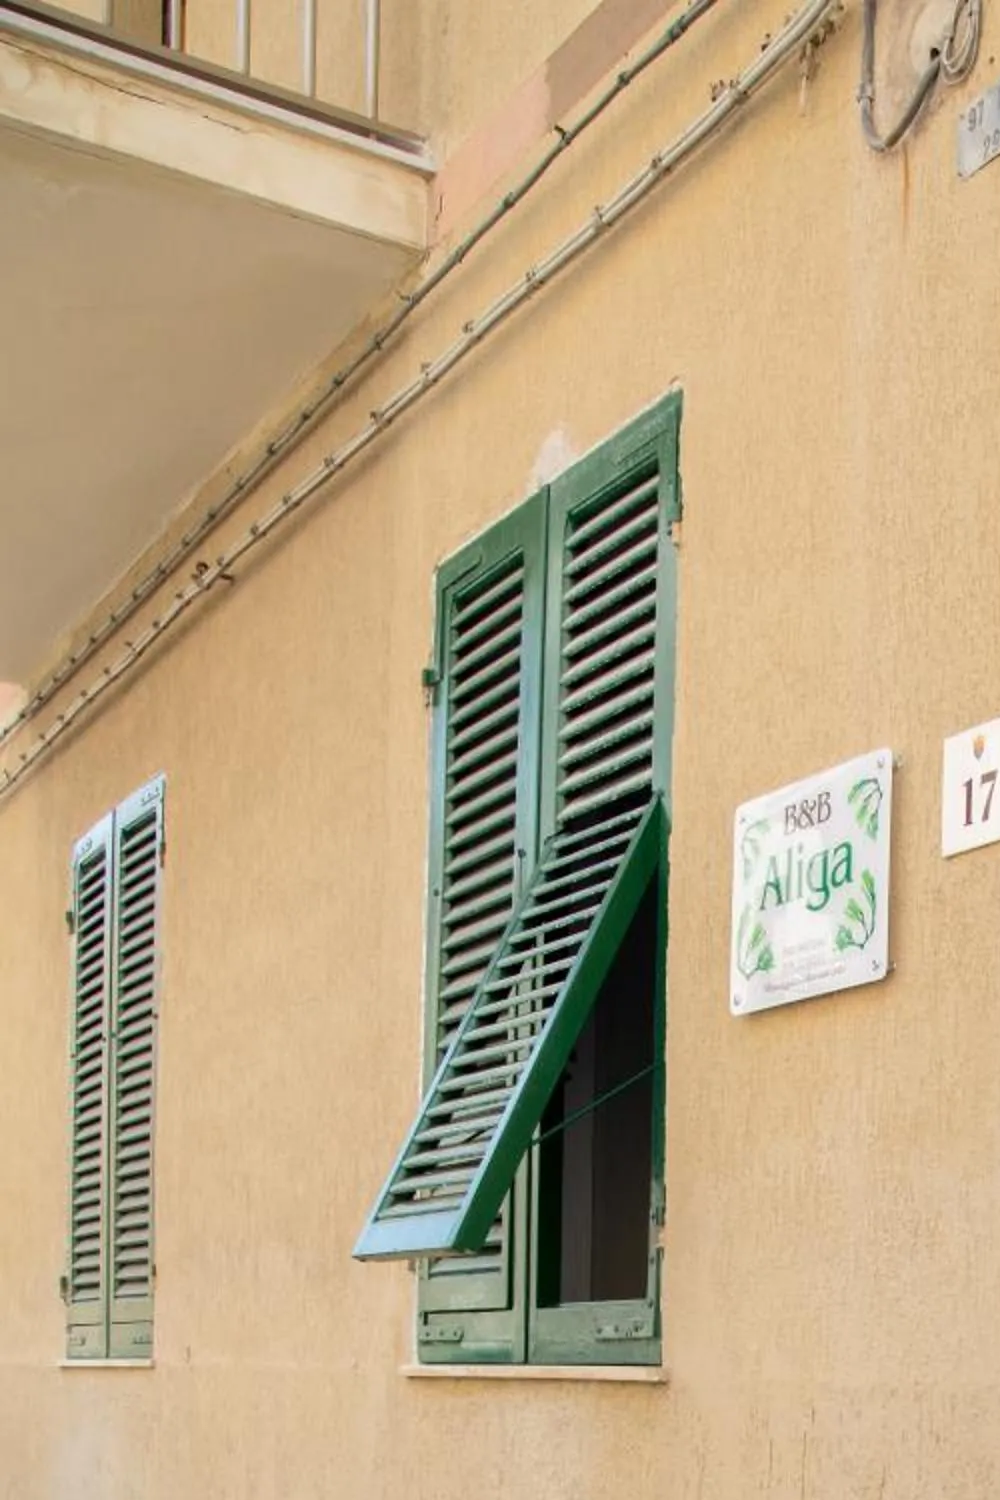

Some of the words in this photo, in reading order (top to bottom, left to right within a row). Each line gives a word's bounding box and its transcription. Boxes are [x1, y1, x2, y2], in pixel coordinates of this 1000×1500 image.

[783, 791, 832, 836] B&B
[962, 769, 998, 827] 17
[759, 841, 854, 912] Aliga
